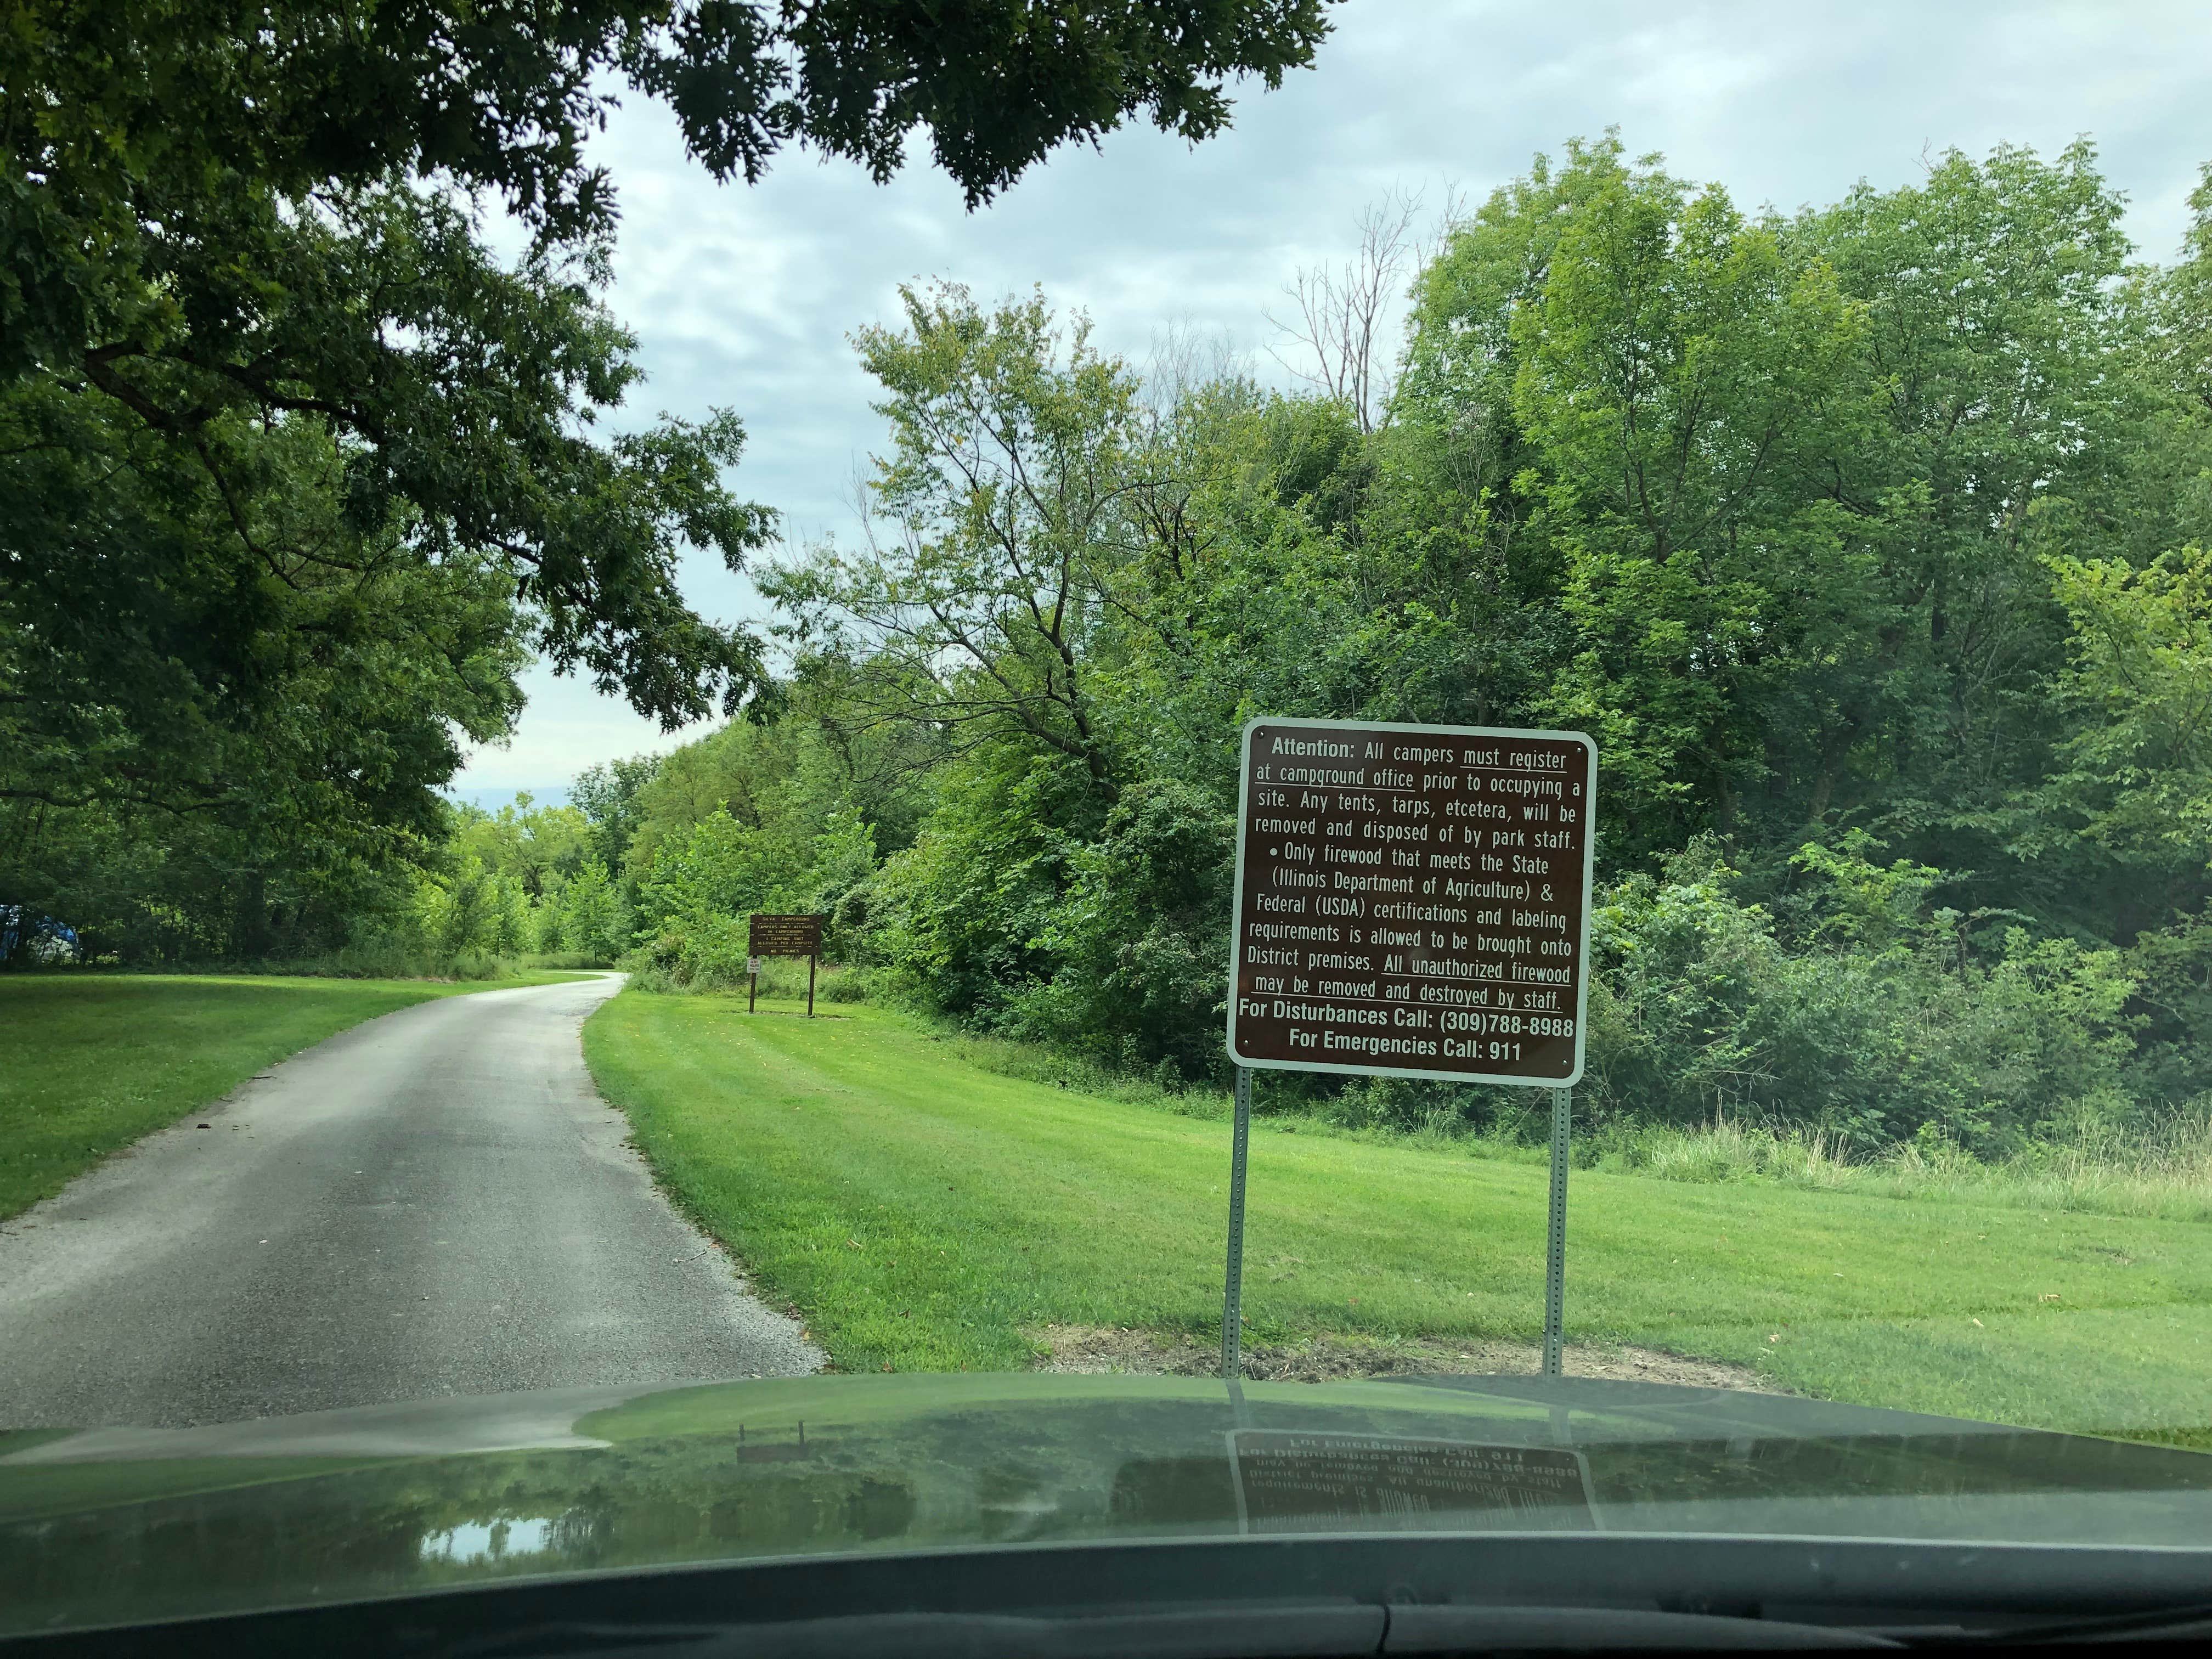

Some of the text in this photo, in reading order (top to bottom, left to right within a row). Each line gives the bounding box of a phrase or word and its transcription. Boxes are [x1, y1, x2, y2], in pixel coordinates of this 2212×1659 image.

[1272, 737, 1566, 772] Attention: All campers must register
[1256, 763, 1580, 800] at campground office prior to occupying a
[1259, 789, 1576, 822] site. Any tents, tarps, etcetera, will be
[1255, 818, 1575, 849] removed and disposed of by park staff.
[1285, 842, 1549, 874] Only firewood that meets the State
[1273, 866, 1553, 901] (Illinois Department of Agriculture) &
[1257, 893, 1566, 934] Federal (USDA) certifications and labeling
[1250, 921, 1571, 958] requirements is allowed to be brought onto
[1248, 946, 1570, 983] District premises. All unauthorized firewood
[1255, 975, 1561, 1011] may be removed and destroyed by staff.
[1239, 998, 1573, 1037] For Disturbances Call: (309)788-8988
[1290, 1028, 1520, 1060] For Emergencies Call: 911
